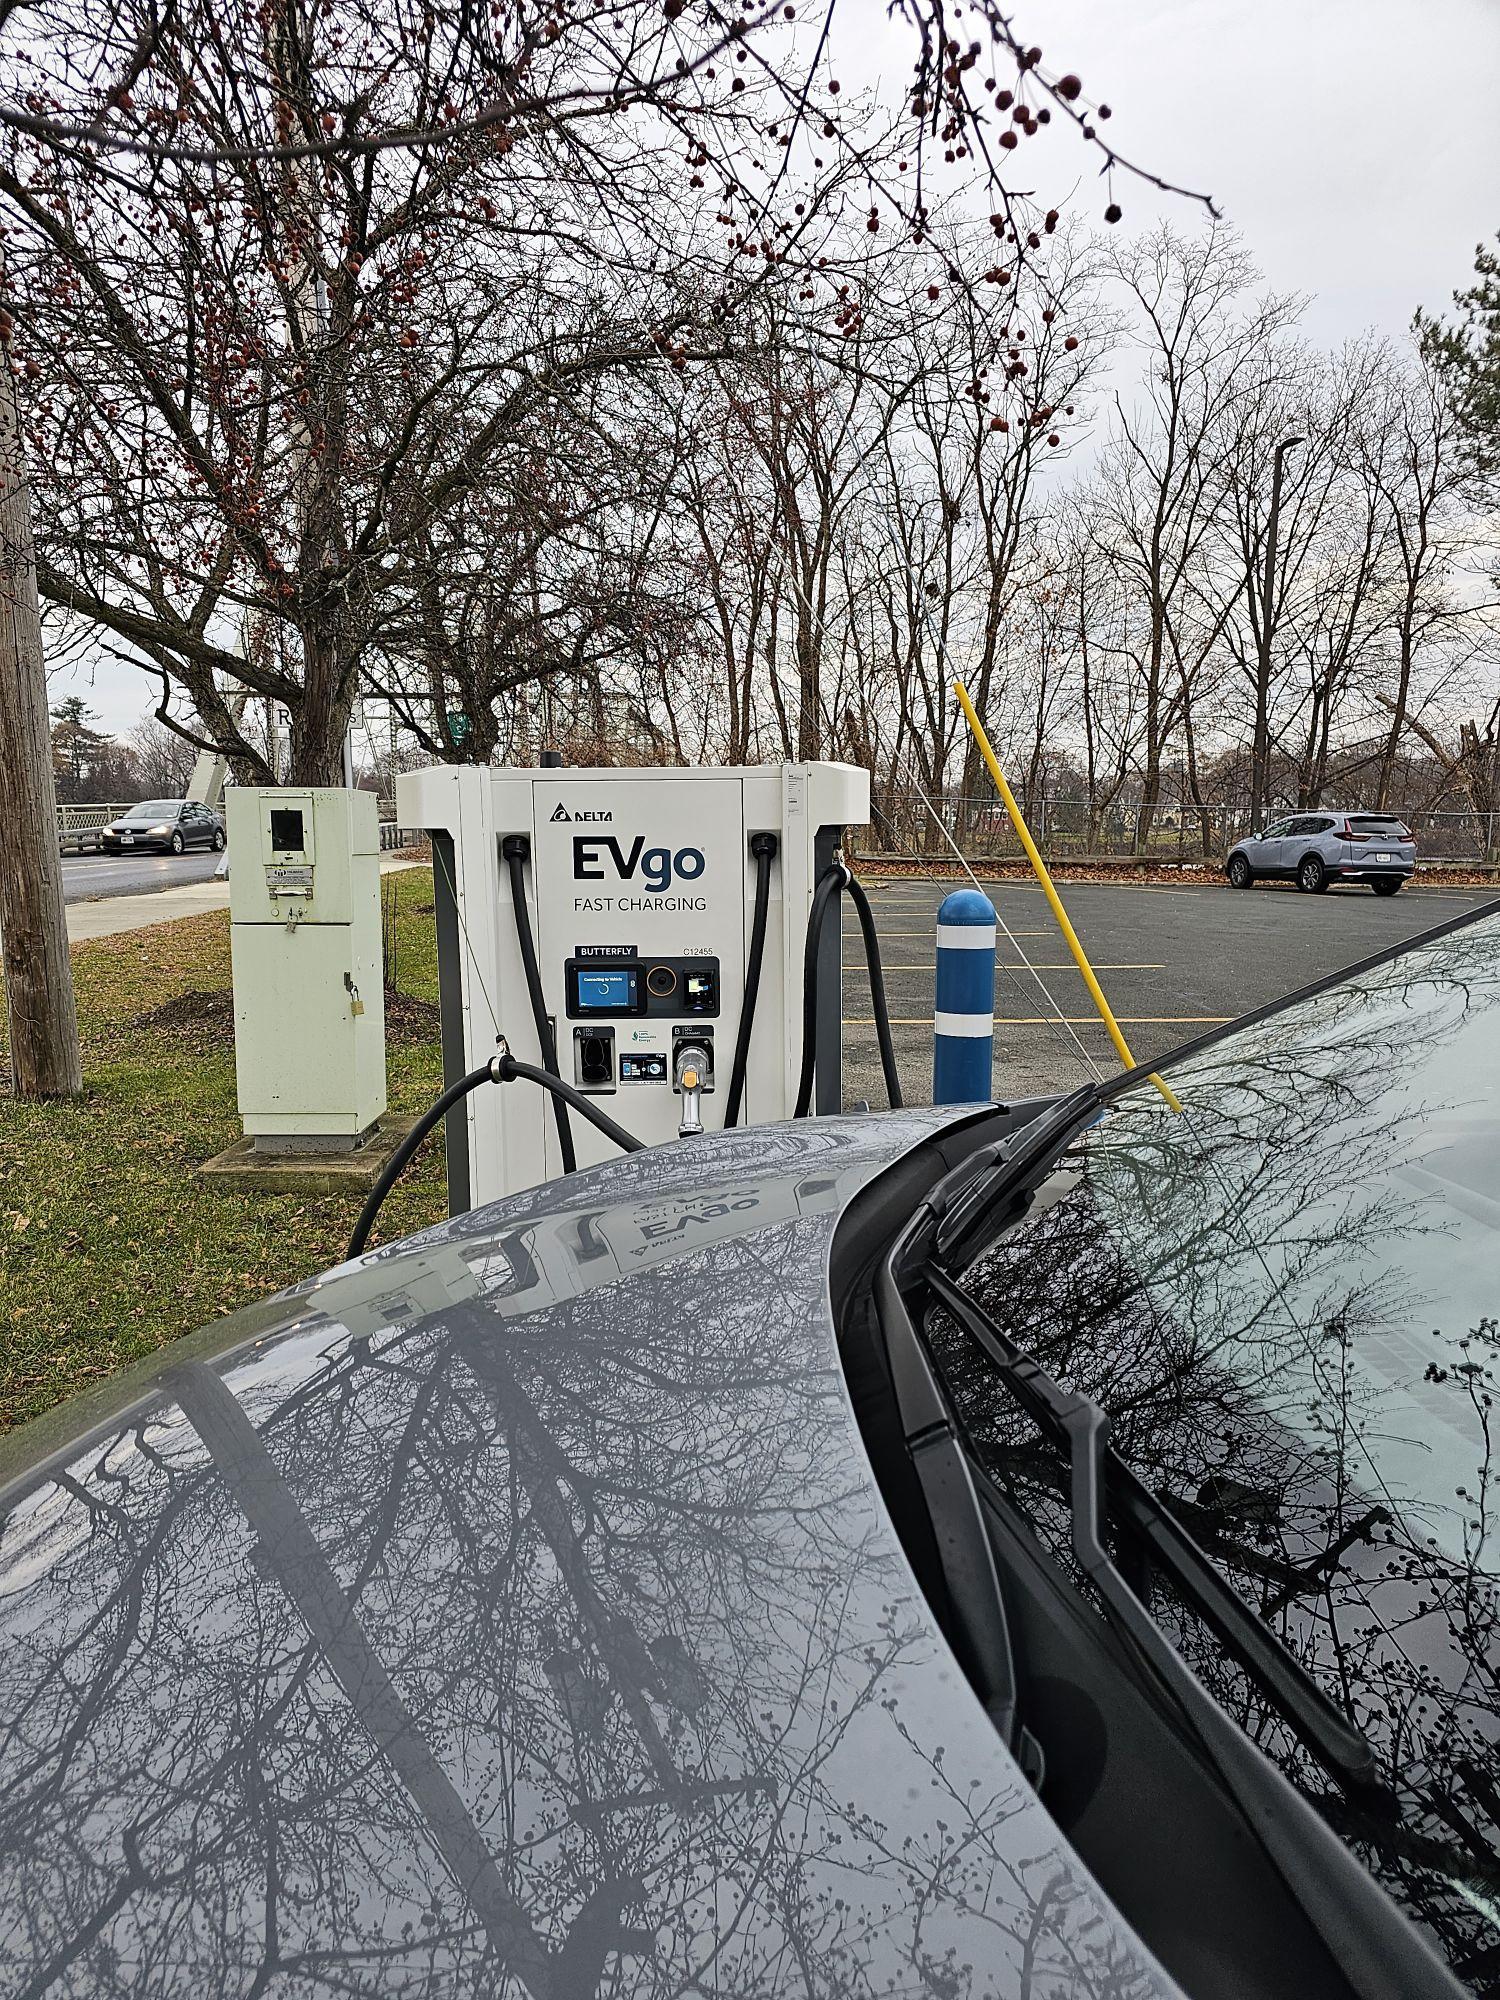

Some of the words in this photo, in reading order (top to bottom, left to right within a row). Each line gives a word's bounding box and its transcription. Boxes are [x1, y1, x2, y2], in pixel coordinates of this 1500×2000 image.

[575, 811, 613, 822] DELTA
[573, 836, 705, 893] EVgo
[574, 898, 613, 911] FAST
[618, 897, 706, 911] CHARGING
[581, 947, 632, 956] BUTTERFLY
[683, 948, 713, 956] C12455
[575, 1028, 582, 1036] A
[674, 1027, 681, 1035] B
